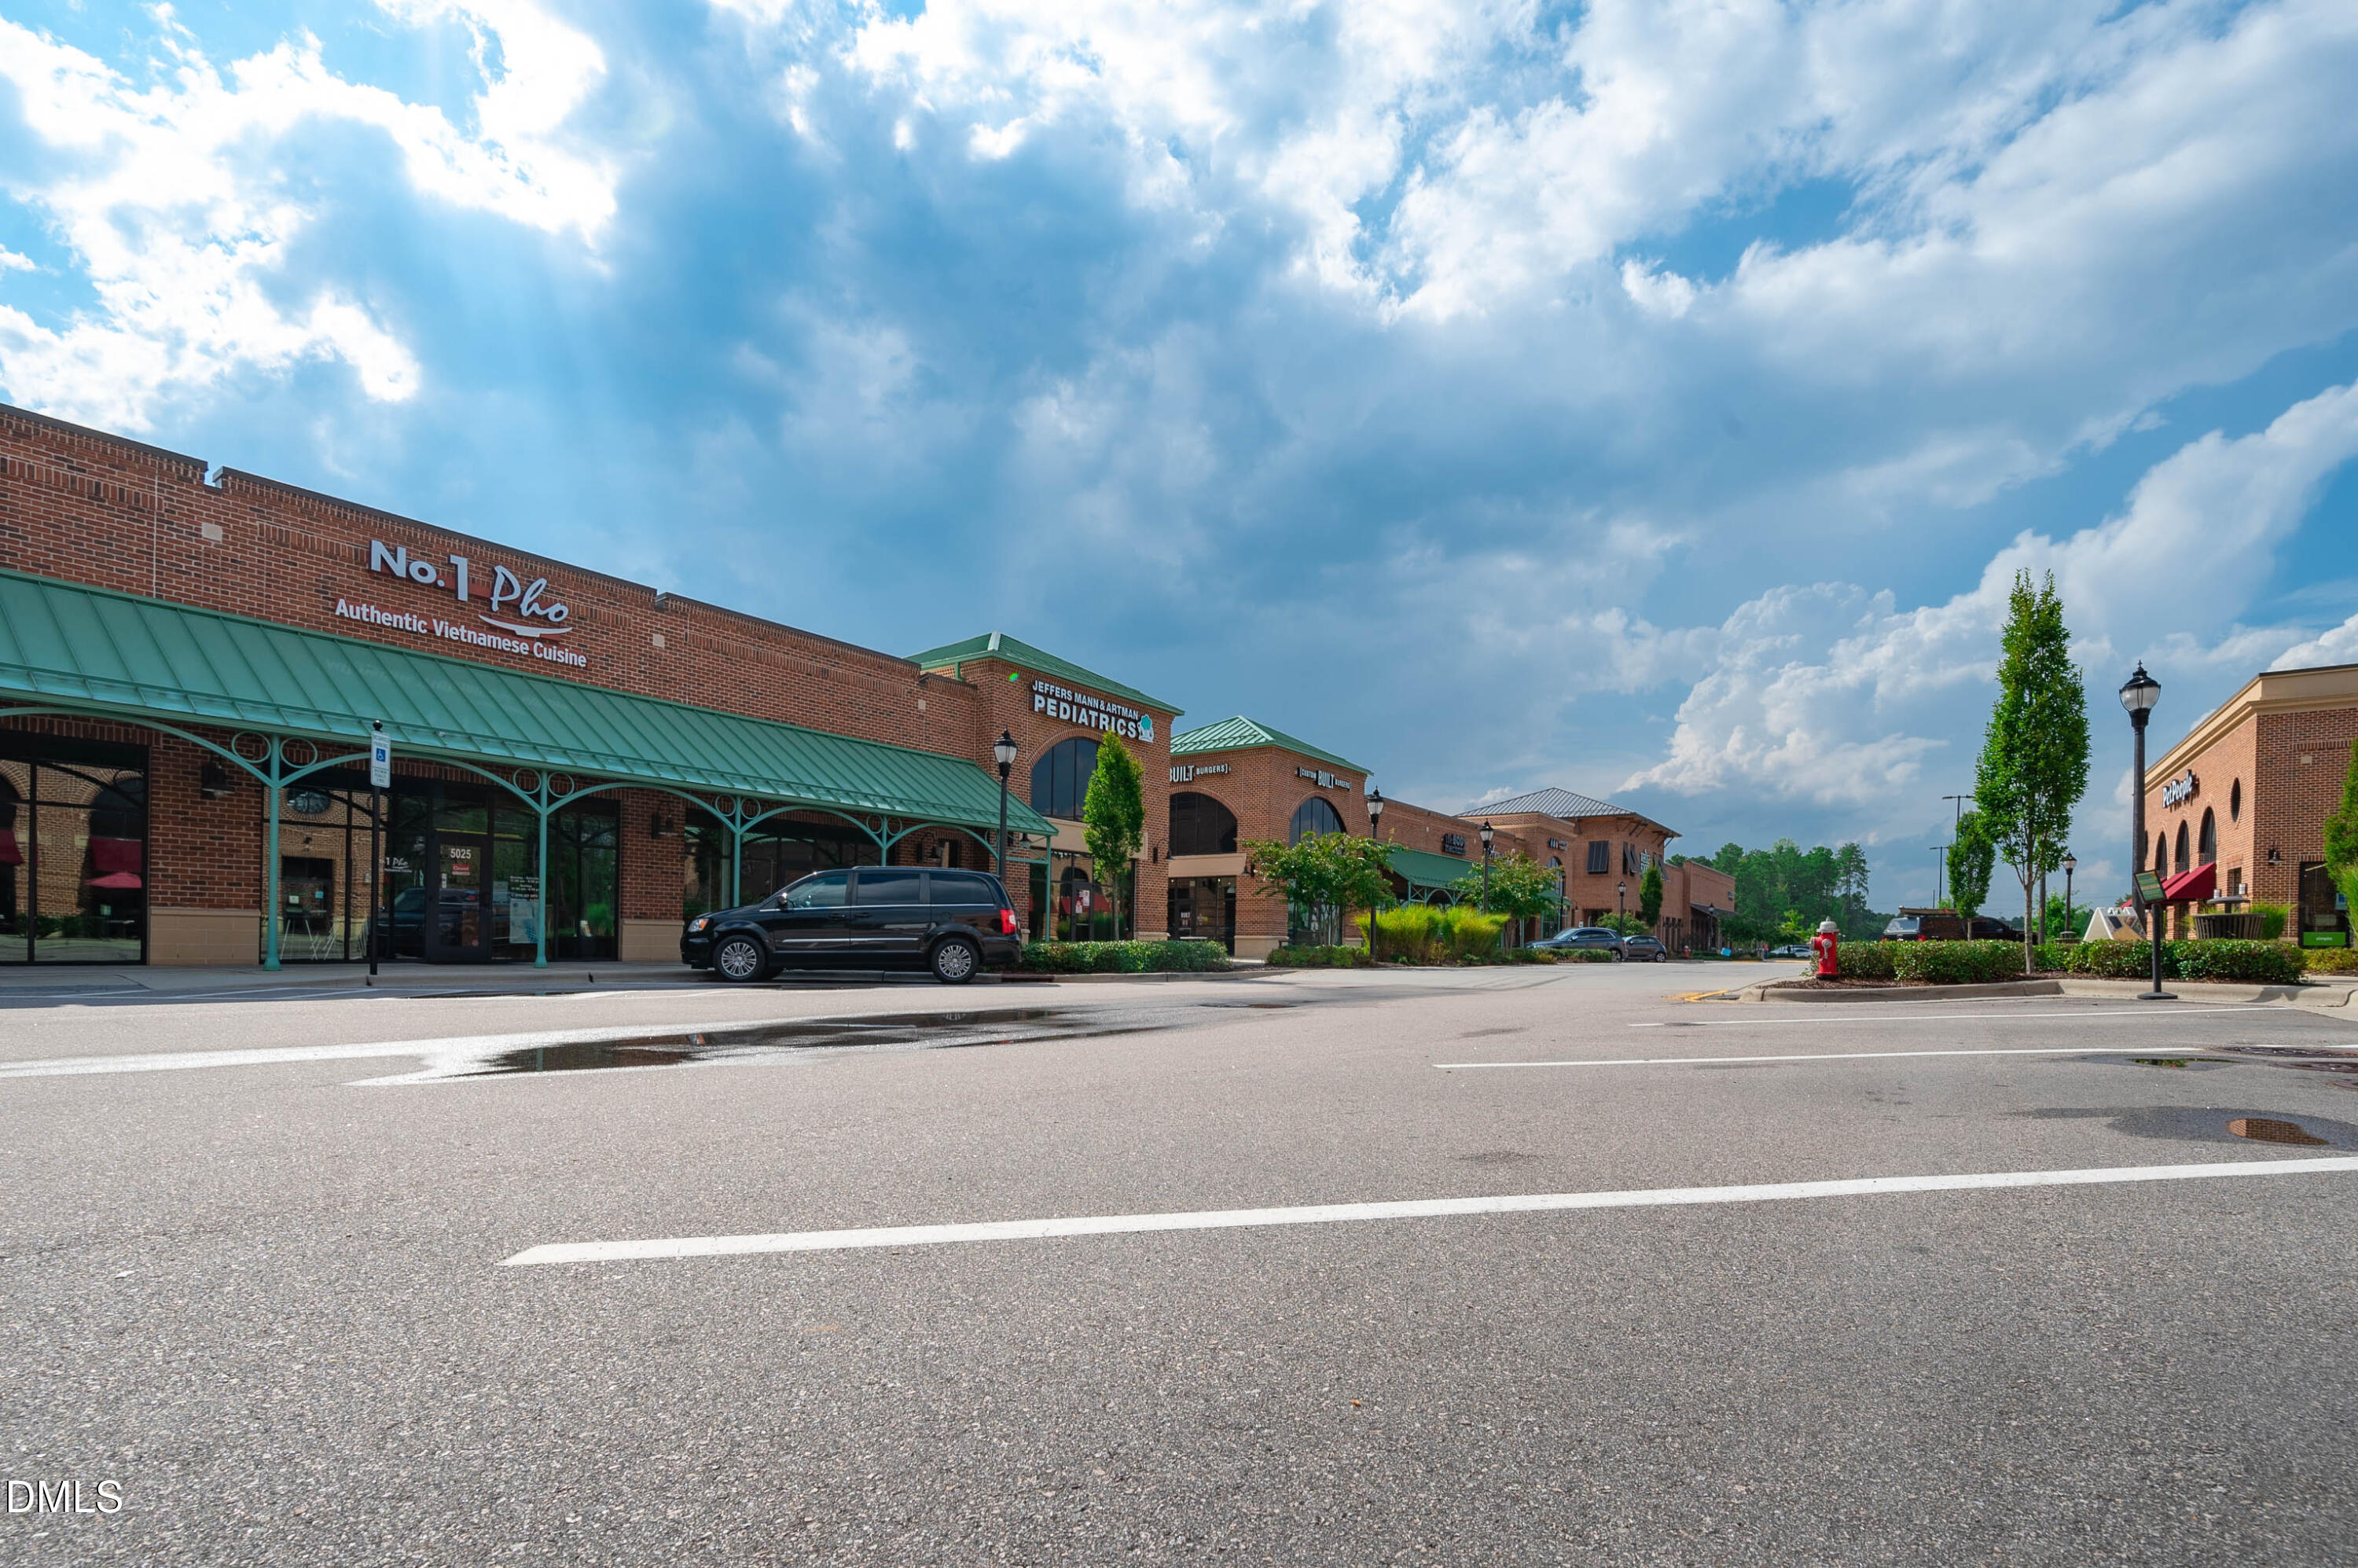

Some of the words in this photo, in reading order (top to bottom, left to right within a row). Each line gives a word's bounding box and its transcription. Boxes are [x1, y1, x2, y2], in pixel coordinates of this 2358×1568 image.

[490, 564, 569, 622] Pho
[336, 598, 428, 634] Authentic
[432, 619, 530, 655] Vietnamese
[533, 641, 587, 667] Cuisine
[1032, 680, 1073, 701] JEFFERS
[1074, 692, 1099, 709] MANN
[1100, 700, 1105, 711] &
[1106, 703, 1138, 721] ARTMAN
[1034, 694, 1137, 739] PEDIATRICS
[1318, 770, 1335, 789] BUILT
[2162, 770, 2192, 808] PetPeople
[450, 849, 471, 859] 5025
